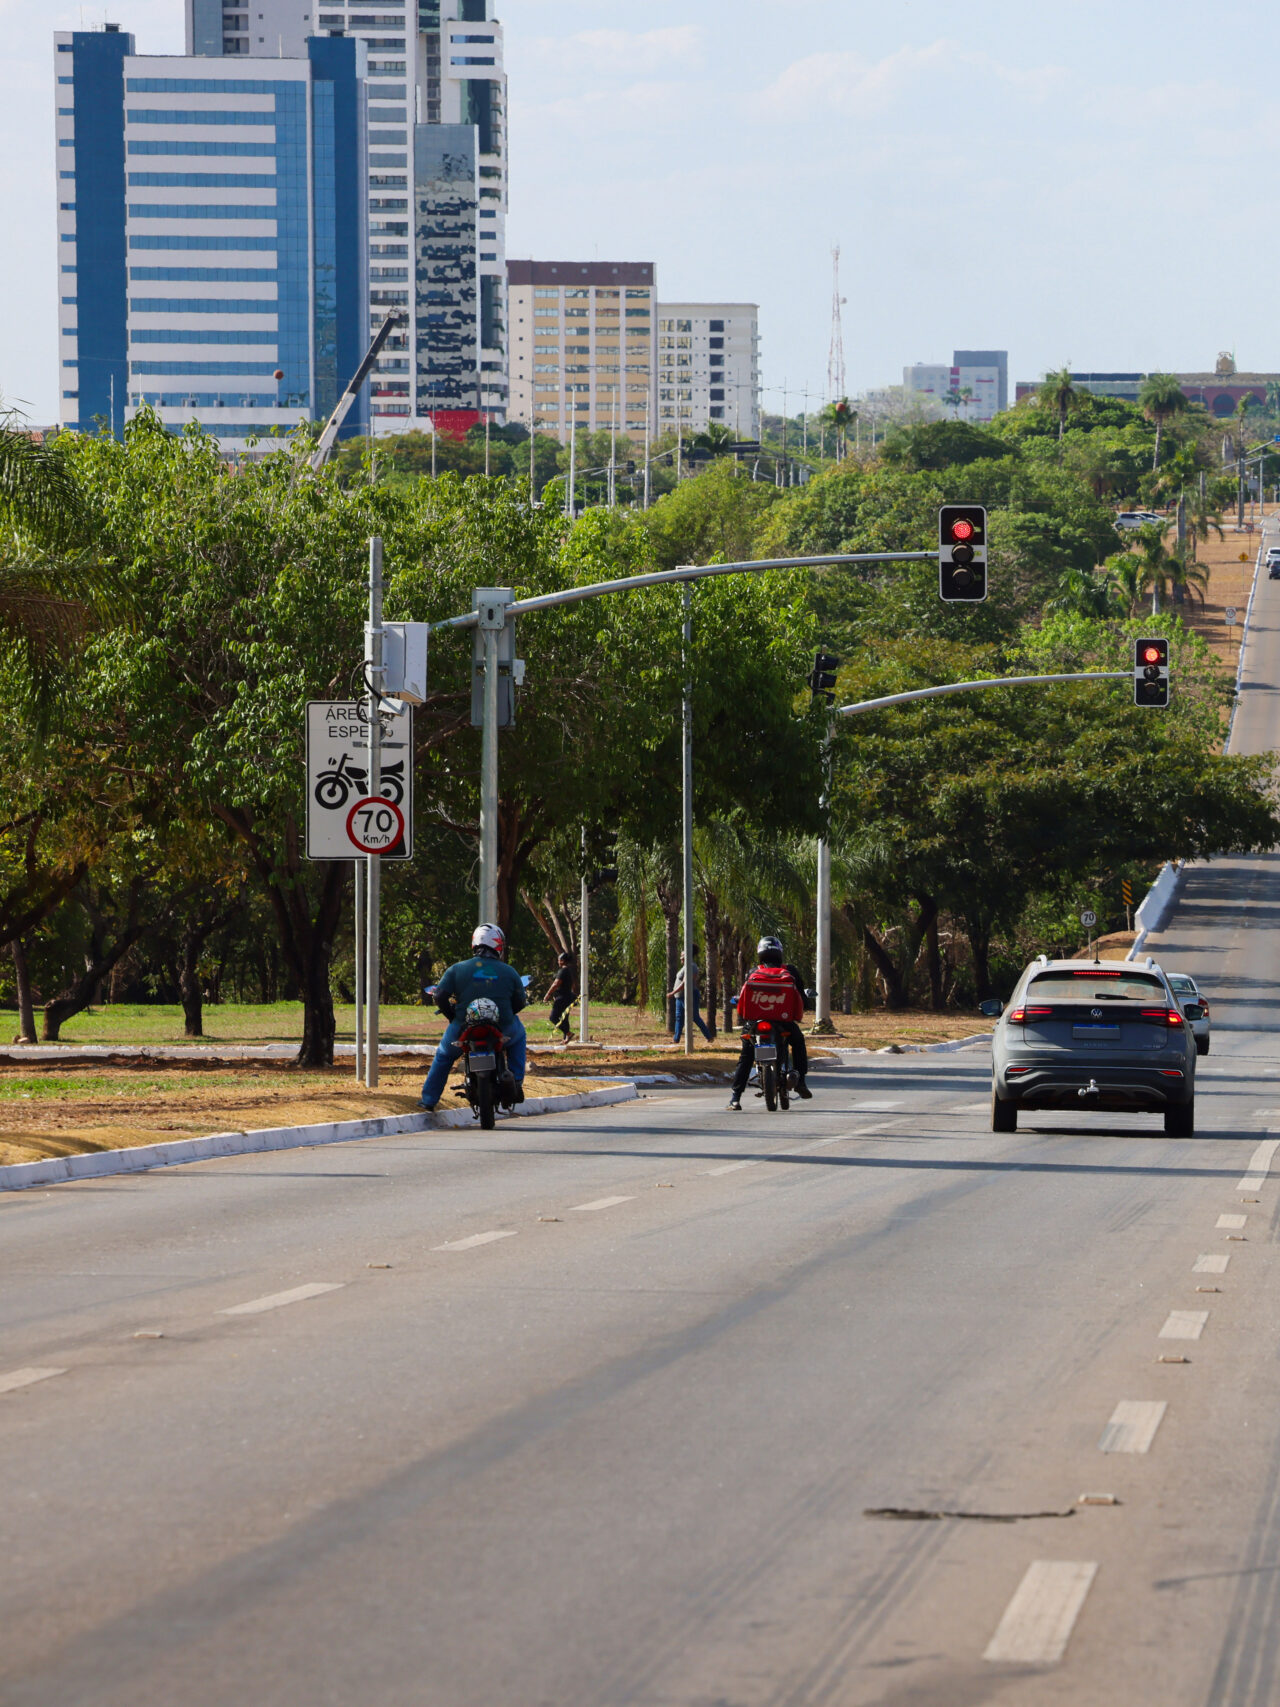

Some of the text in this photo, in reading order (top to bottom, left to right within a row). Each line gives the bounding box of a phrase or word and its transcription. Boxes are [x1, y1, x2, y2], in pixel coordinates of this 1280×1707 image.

[325, 705, 368, 720] ÁREA
[328, 725, 369, 738] ESPE
[358, 810, 392, 832] 70
[363, 835, 391, 844] Km/h
[1084, 913, 1095, 922] 70
